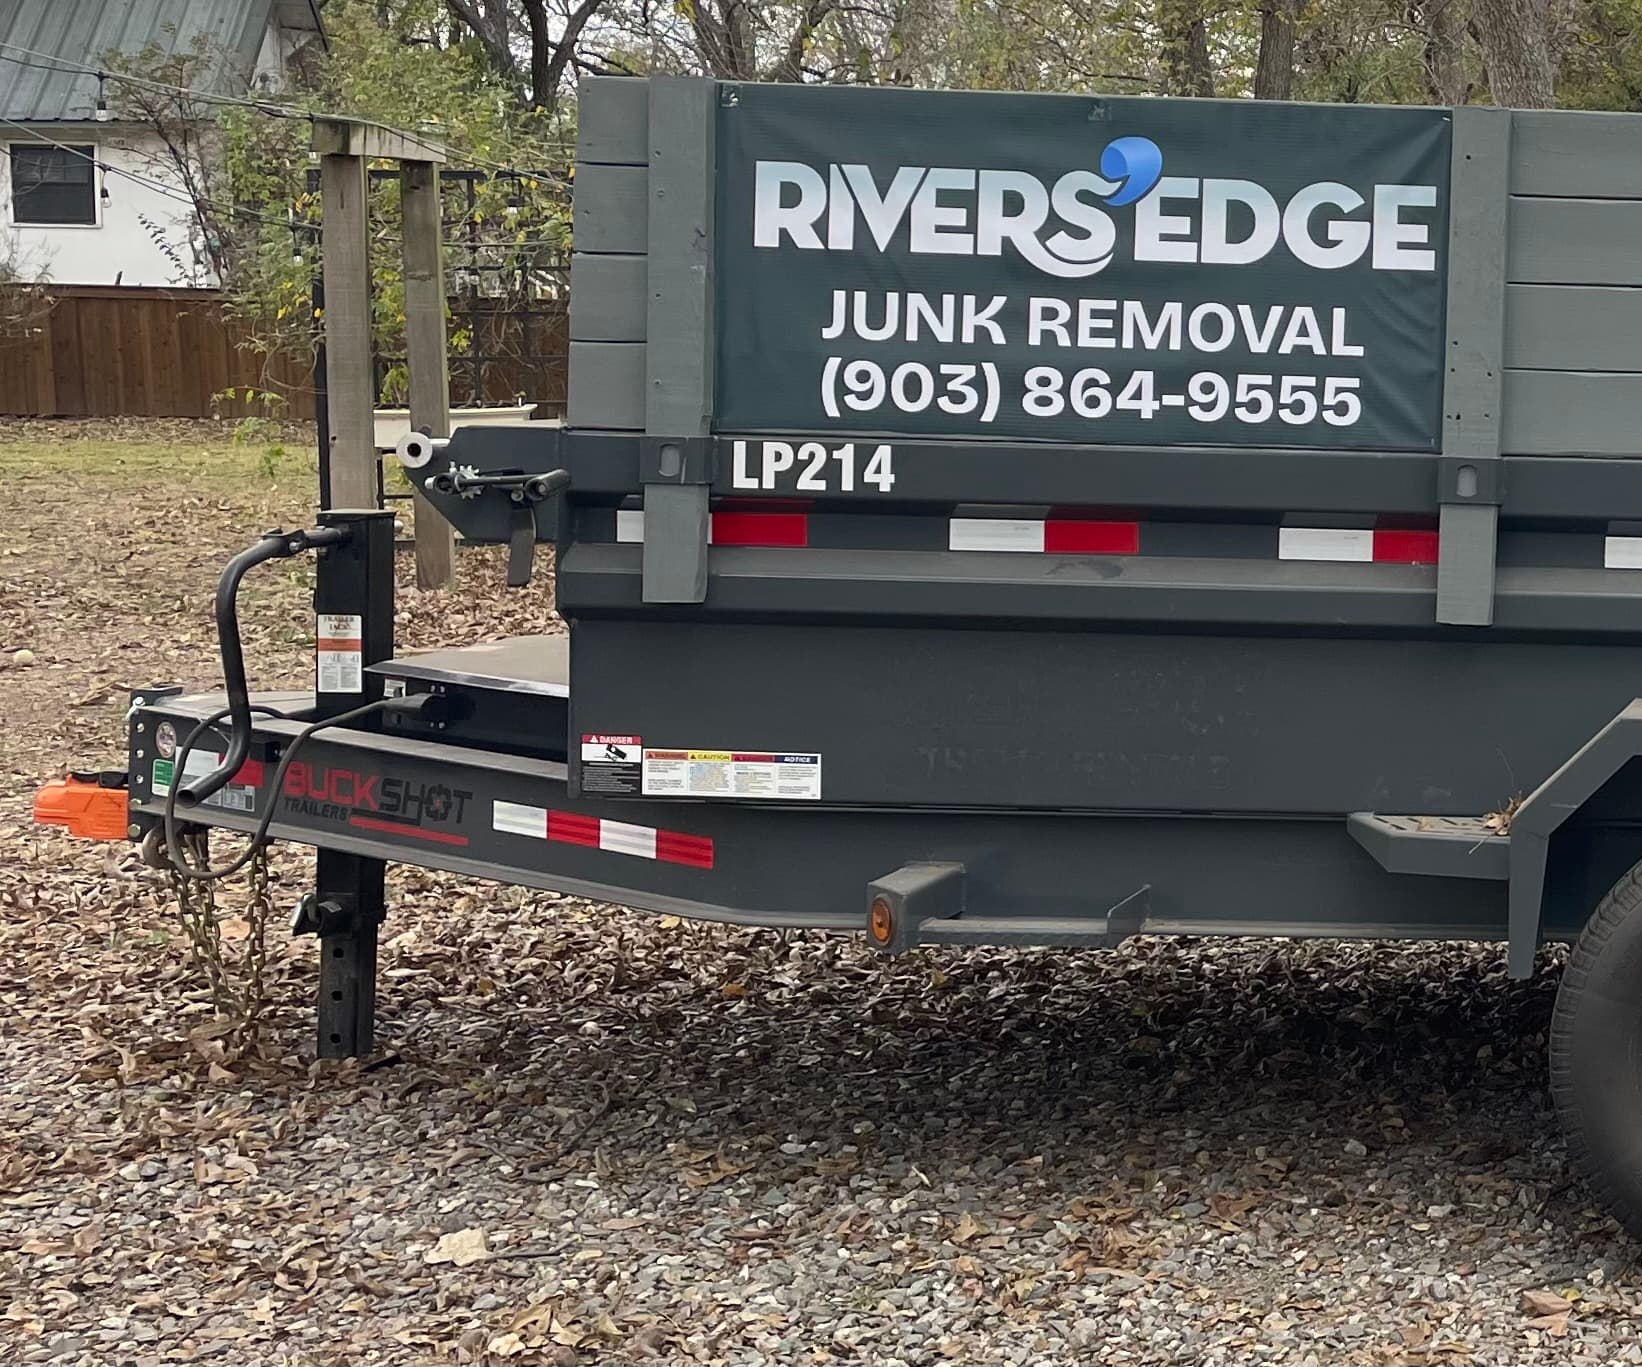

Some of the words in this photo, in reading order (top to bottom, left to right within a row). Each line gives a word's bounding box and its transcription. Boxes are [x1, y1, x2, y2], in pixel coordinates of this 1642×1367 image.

[821, 289, 1008, 345] JUNK
[1028, 297, 1365, 357] REMOVAL
[821, 356, 1001, 423] (903)
[1022, 366, 1362, 427] 864-9555
[732, 440, 896, 493] LP214
[600, 735, 633, 744] DANGER
[697, 753, 730, 761] CAUTION
[284, 797, 348, 822] TRAILERS
